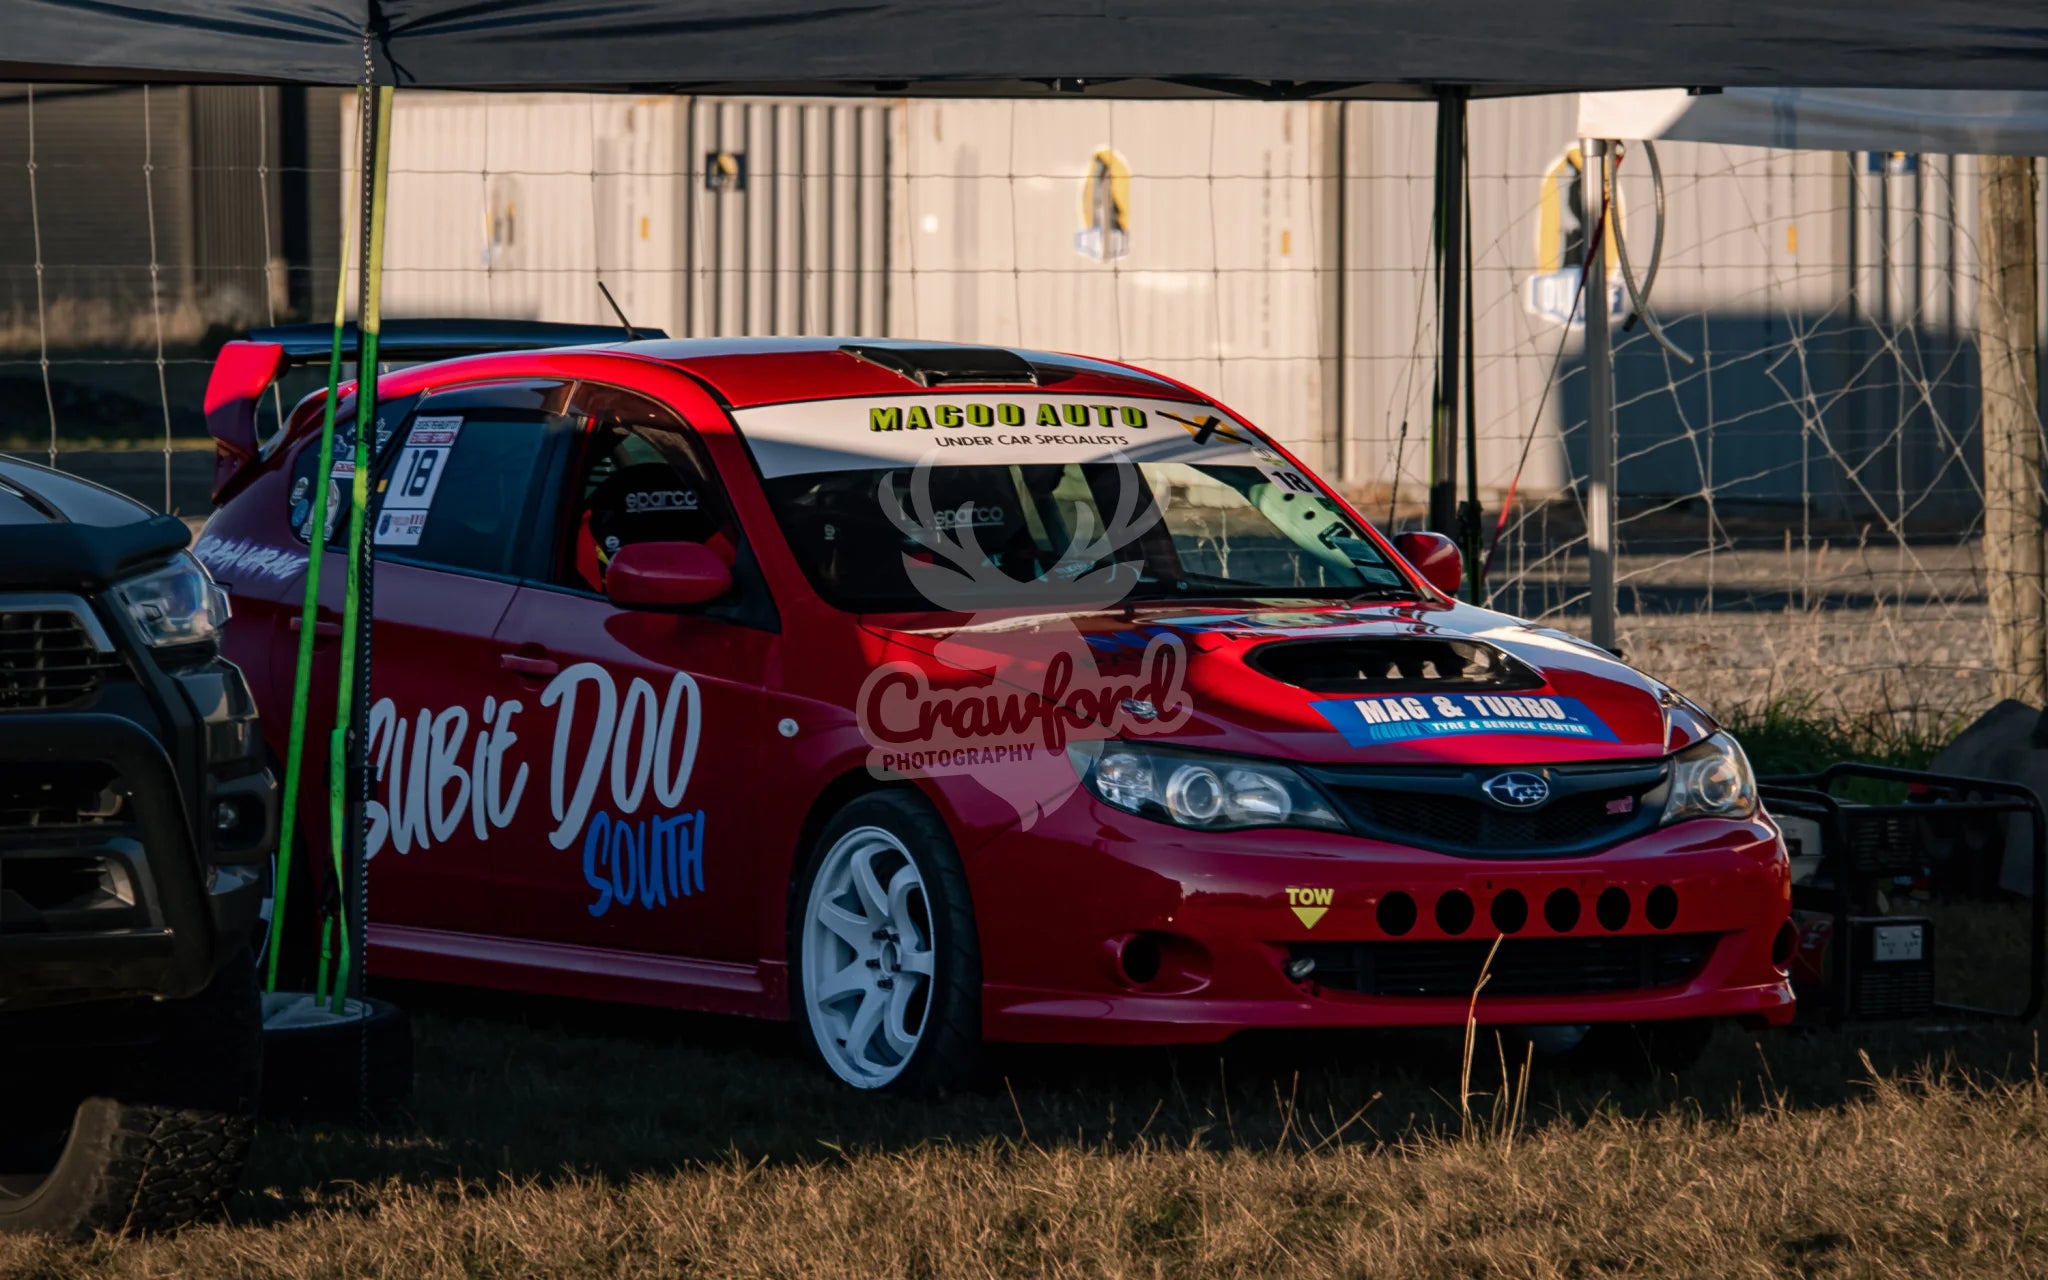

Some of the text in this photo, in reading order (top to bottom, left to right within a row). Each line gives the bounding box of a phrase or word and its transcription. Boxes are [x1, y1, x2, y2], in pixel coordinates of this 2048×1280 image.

[869, 403, 1148, 431] MAGOO AUTO
[935, 434, 1129, 447] UNDER CAR SPECIALISTS
[400, 449, 439, 497] 18
[1271, 471, 1314, 493] 18
[934, 506, 1004, 526] sparco
[1354, 696, 1567, 724] MAG & TURBO
[1432, 721, 1588, 733] TYRE & SERVICE CENTRE
[583, 809, 706, 918] SOUTH
[1285, 888, 1334, 905] TOW
